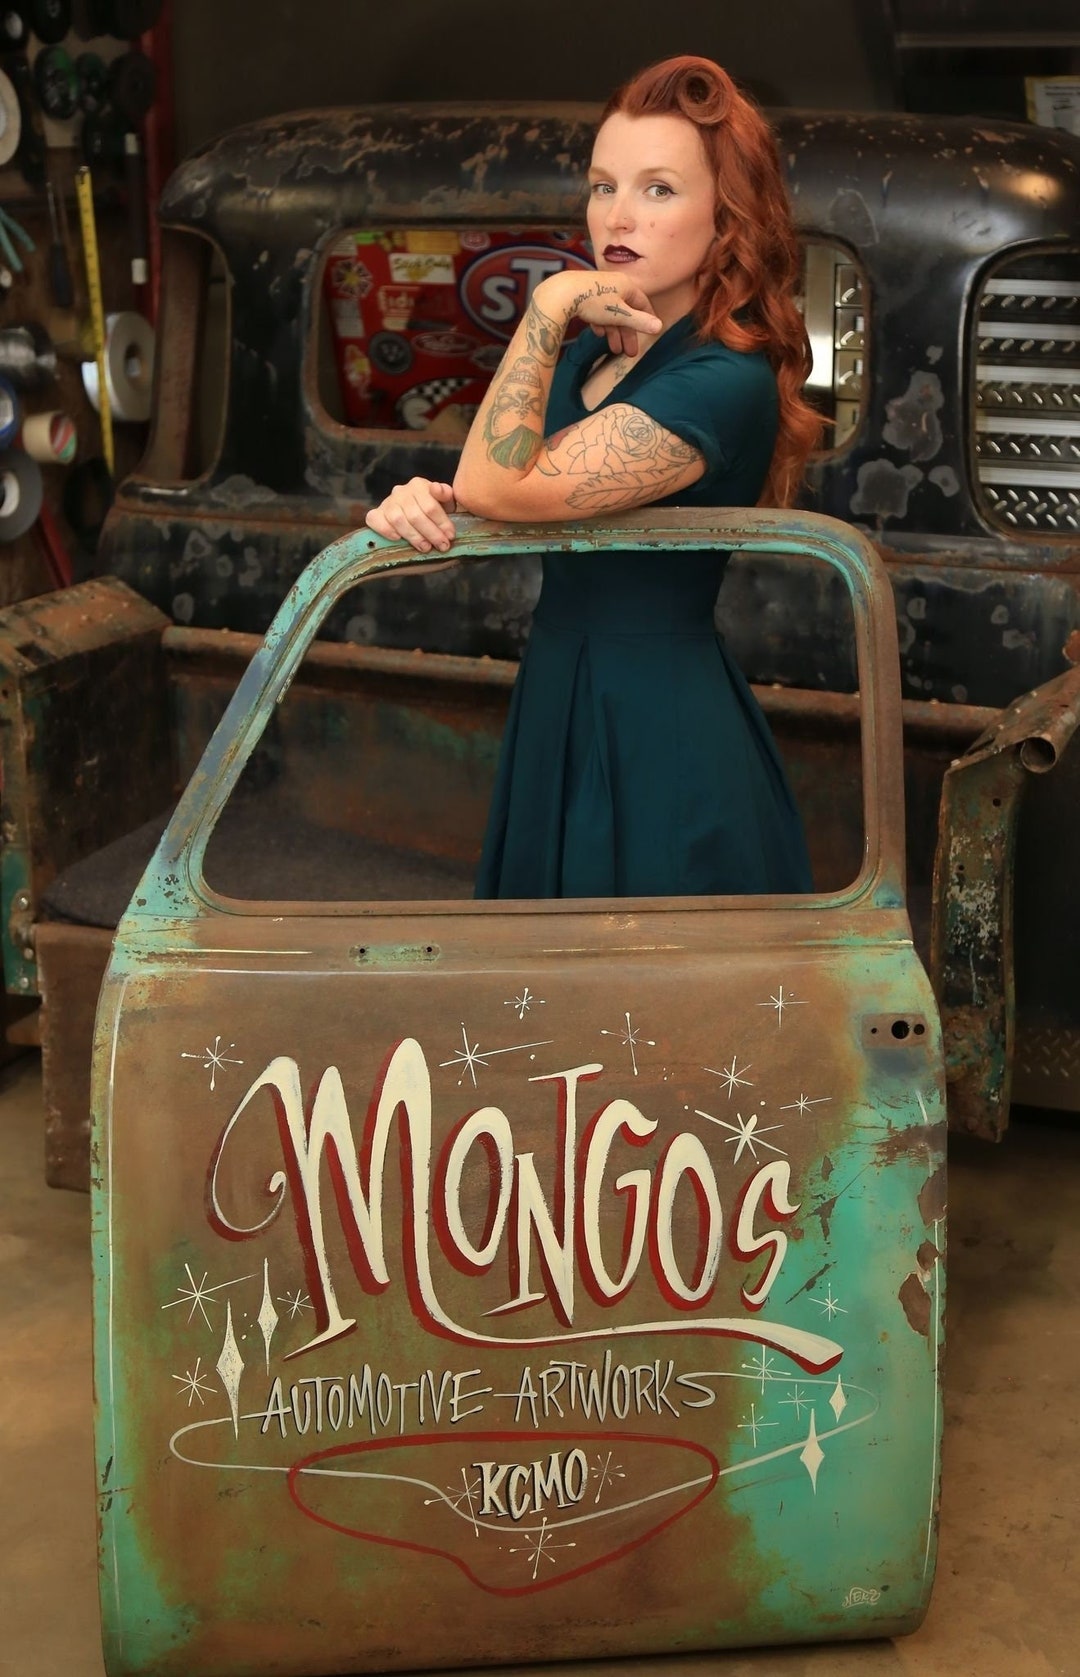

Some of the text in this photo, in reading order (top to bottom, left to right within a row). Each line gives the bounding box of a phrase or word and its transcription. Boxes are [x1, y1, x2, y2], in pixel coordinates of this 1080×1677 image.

[242, 1350, 717, 1438] AUTOMOTIVE ARTWORKS
[473, 1448, 589, 1520] KCMO
